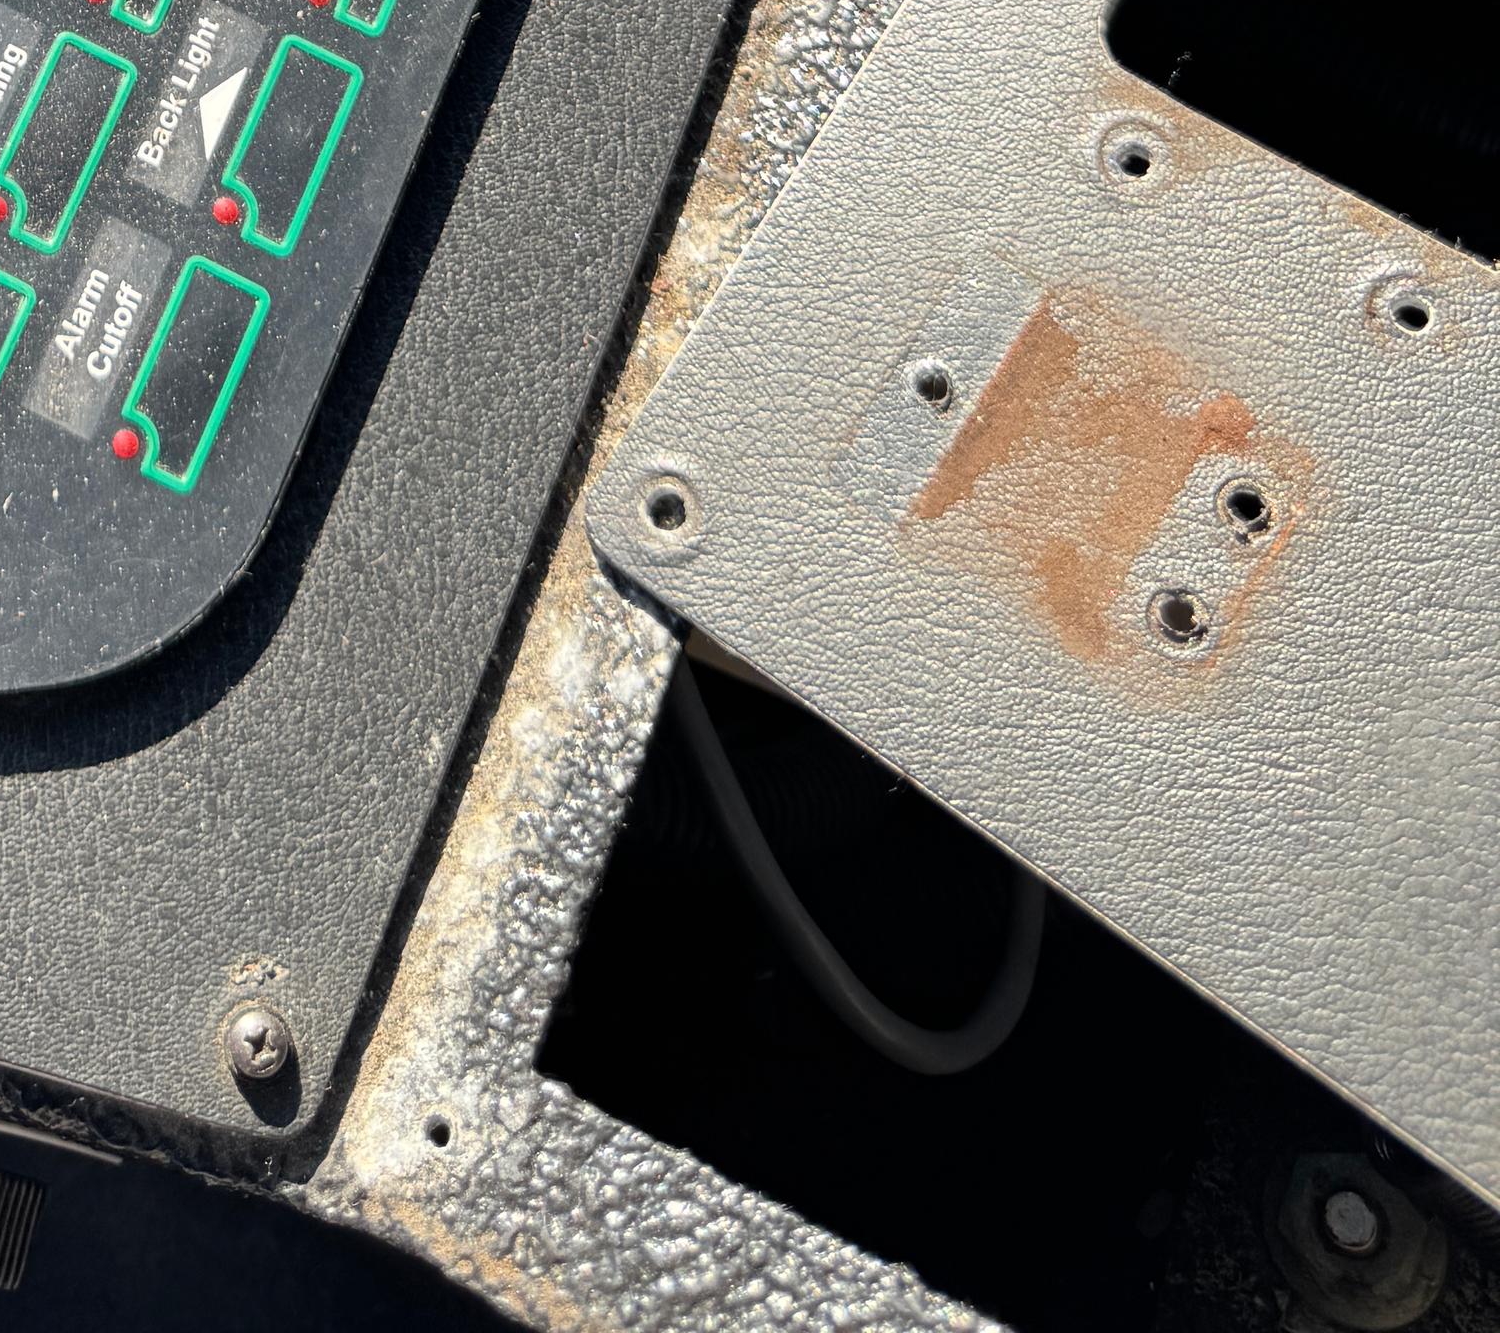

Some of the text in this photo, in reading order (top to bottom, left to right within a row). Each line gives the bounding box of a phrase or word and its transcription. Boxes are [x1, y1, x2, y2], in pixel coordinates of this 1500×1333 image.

[137, 15, 221, 168] Back Light
[55, 268, 110, 360] Alarm
[87, 280, 145, 379] Cutoff
